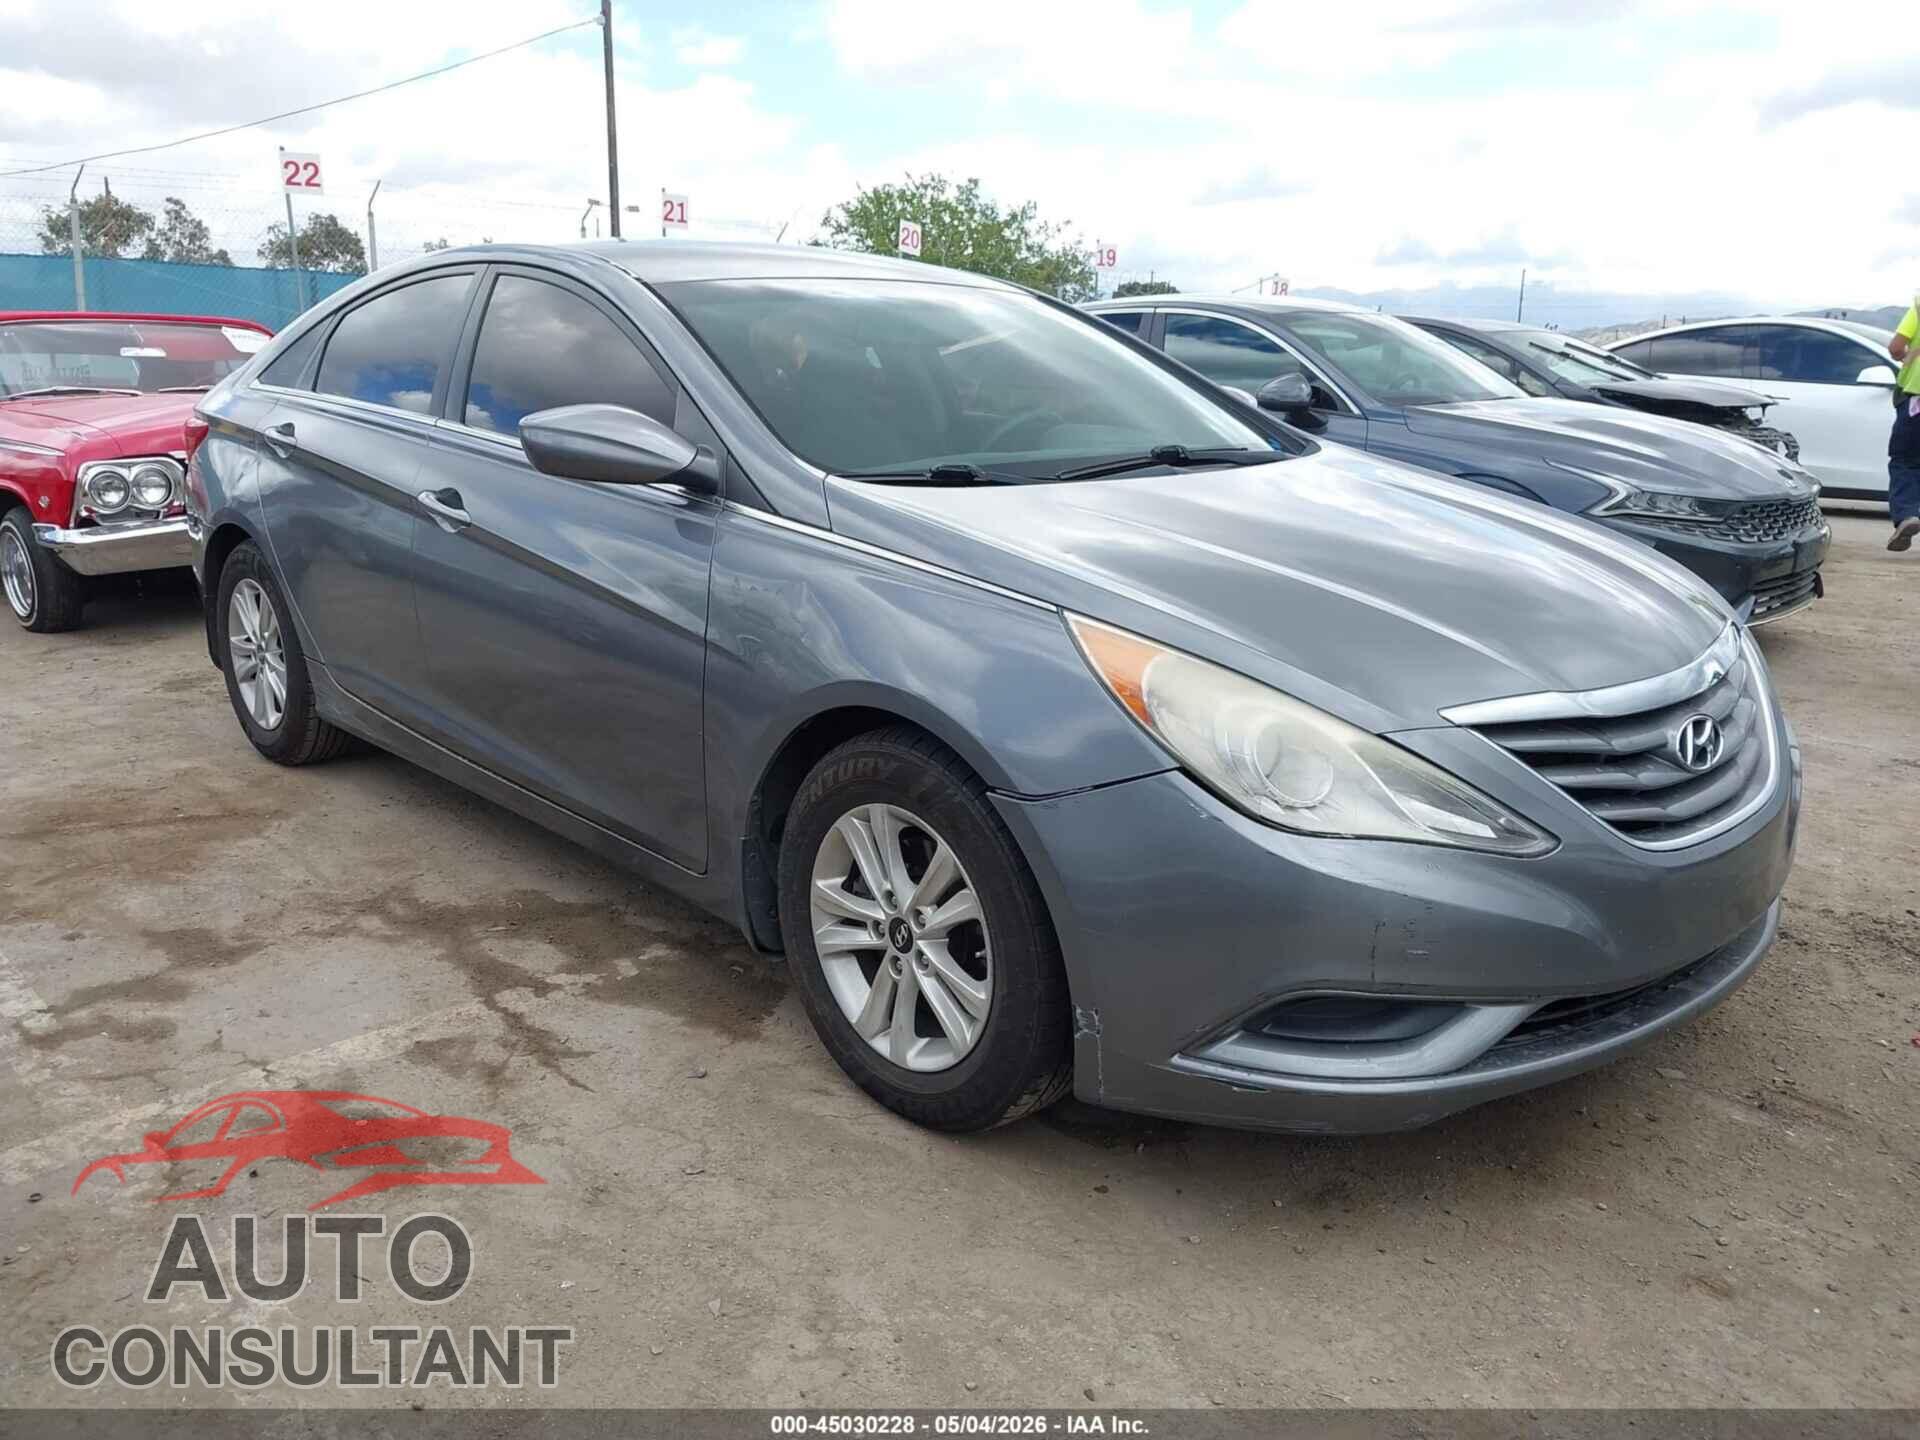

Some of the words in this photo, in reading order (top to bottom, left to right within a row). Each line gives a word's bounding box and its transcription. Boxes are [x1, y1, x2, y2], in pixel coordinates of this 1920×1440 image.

[284, 160, 321, 187] 22
[663, 200, 688, 224] 21
[901, 227, 919, 249] 20
[1096, 248, 1116, 267] 19
